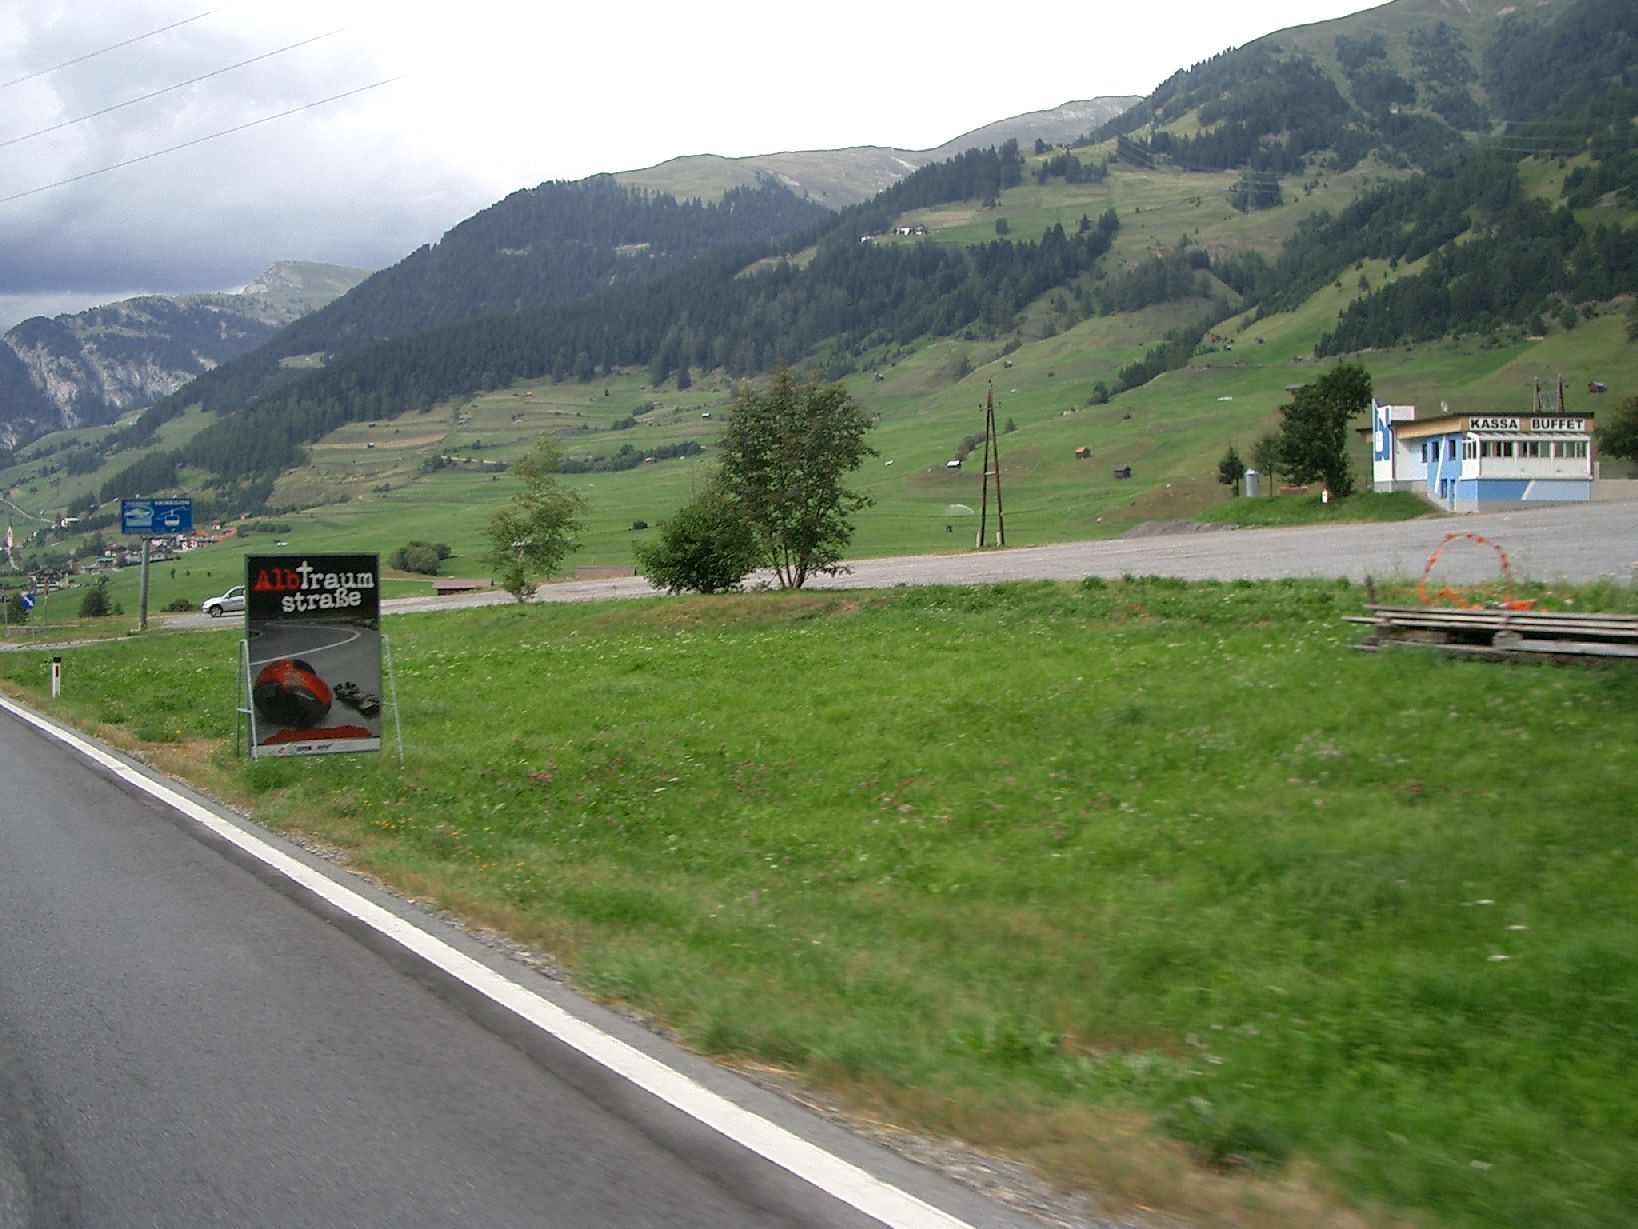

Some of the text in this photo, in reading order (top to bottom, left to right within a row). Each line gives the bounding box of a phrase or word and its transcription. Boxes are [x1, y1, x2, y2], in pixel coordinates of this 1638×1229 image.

[1470, 419, 1518, 429] KASSA
[1532, 419, 1584, 429] BUFFET
[255, 561, 374, 591] Albtraum
[282, 589, 362, 613] straße
